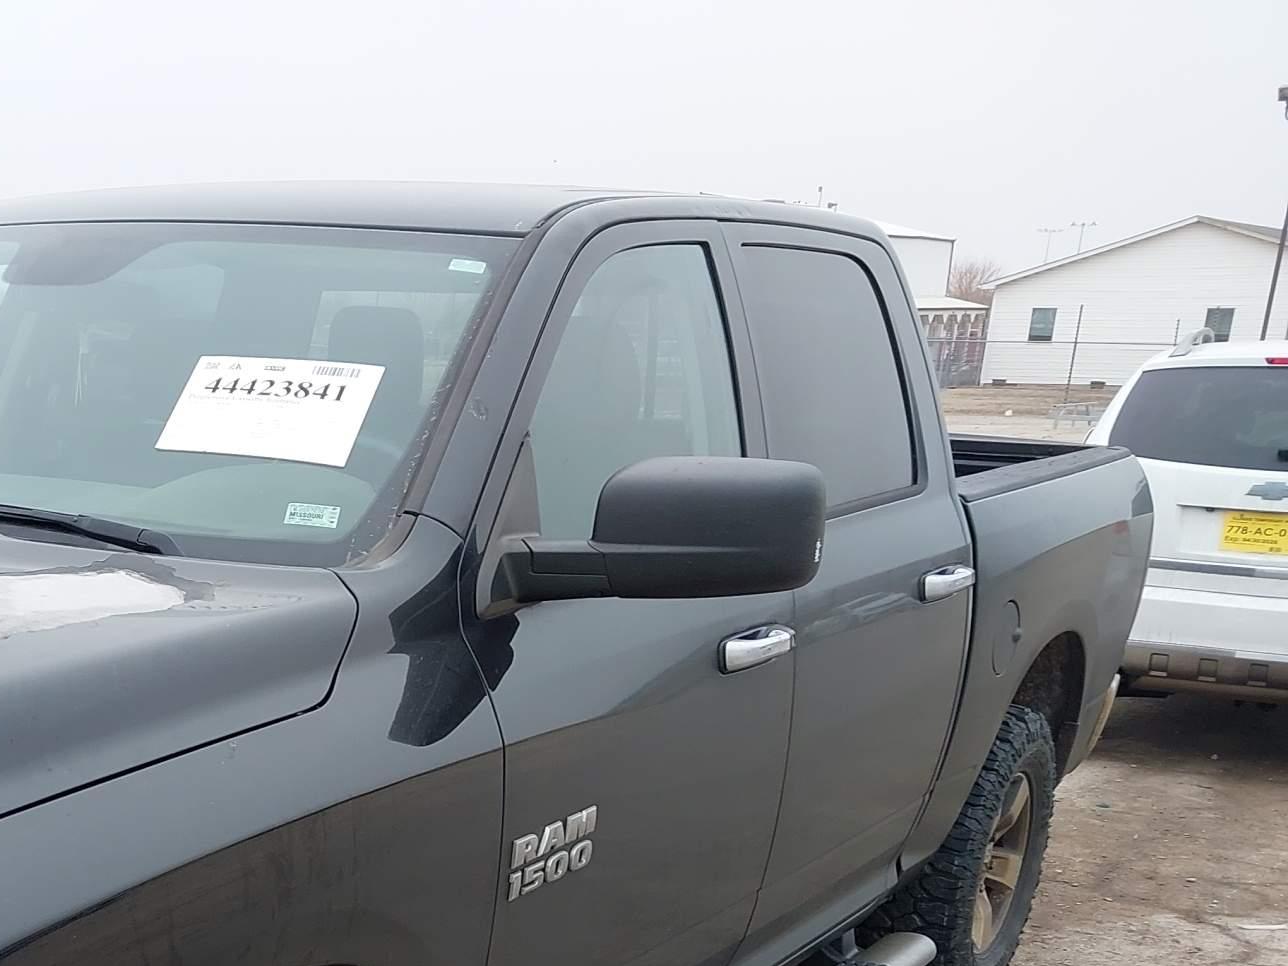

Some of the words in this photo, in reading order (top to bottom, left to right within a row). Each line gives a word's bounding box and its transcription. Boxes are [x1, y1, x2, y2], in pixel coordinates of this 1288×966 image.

[204, 377, 347, 402] 44423841
[511, 804, 598, 870] RAM
[508, 839, 593, 902] 1500
